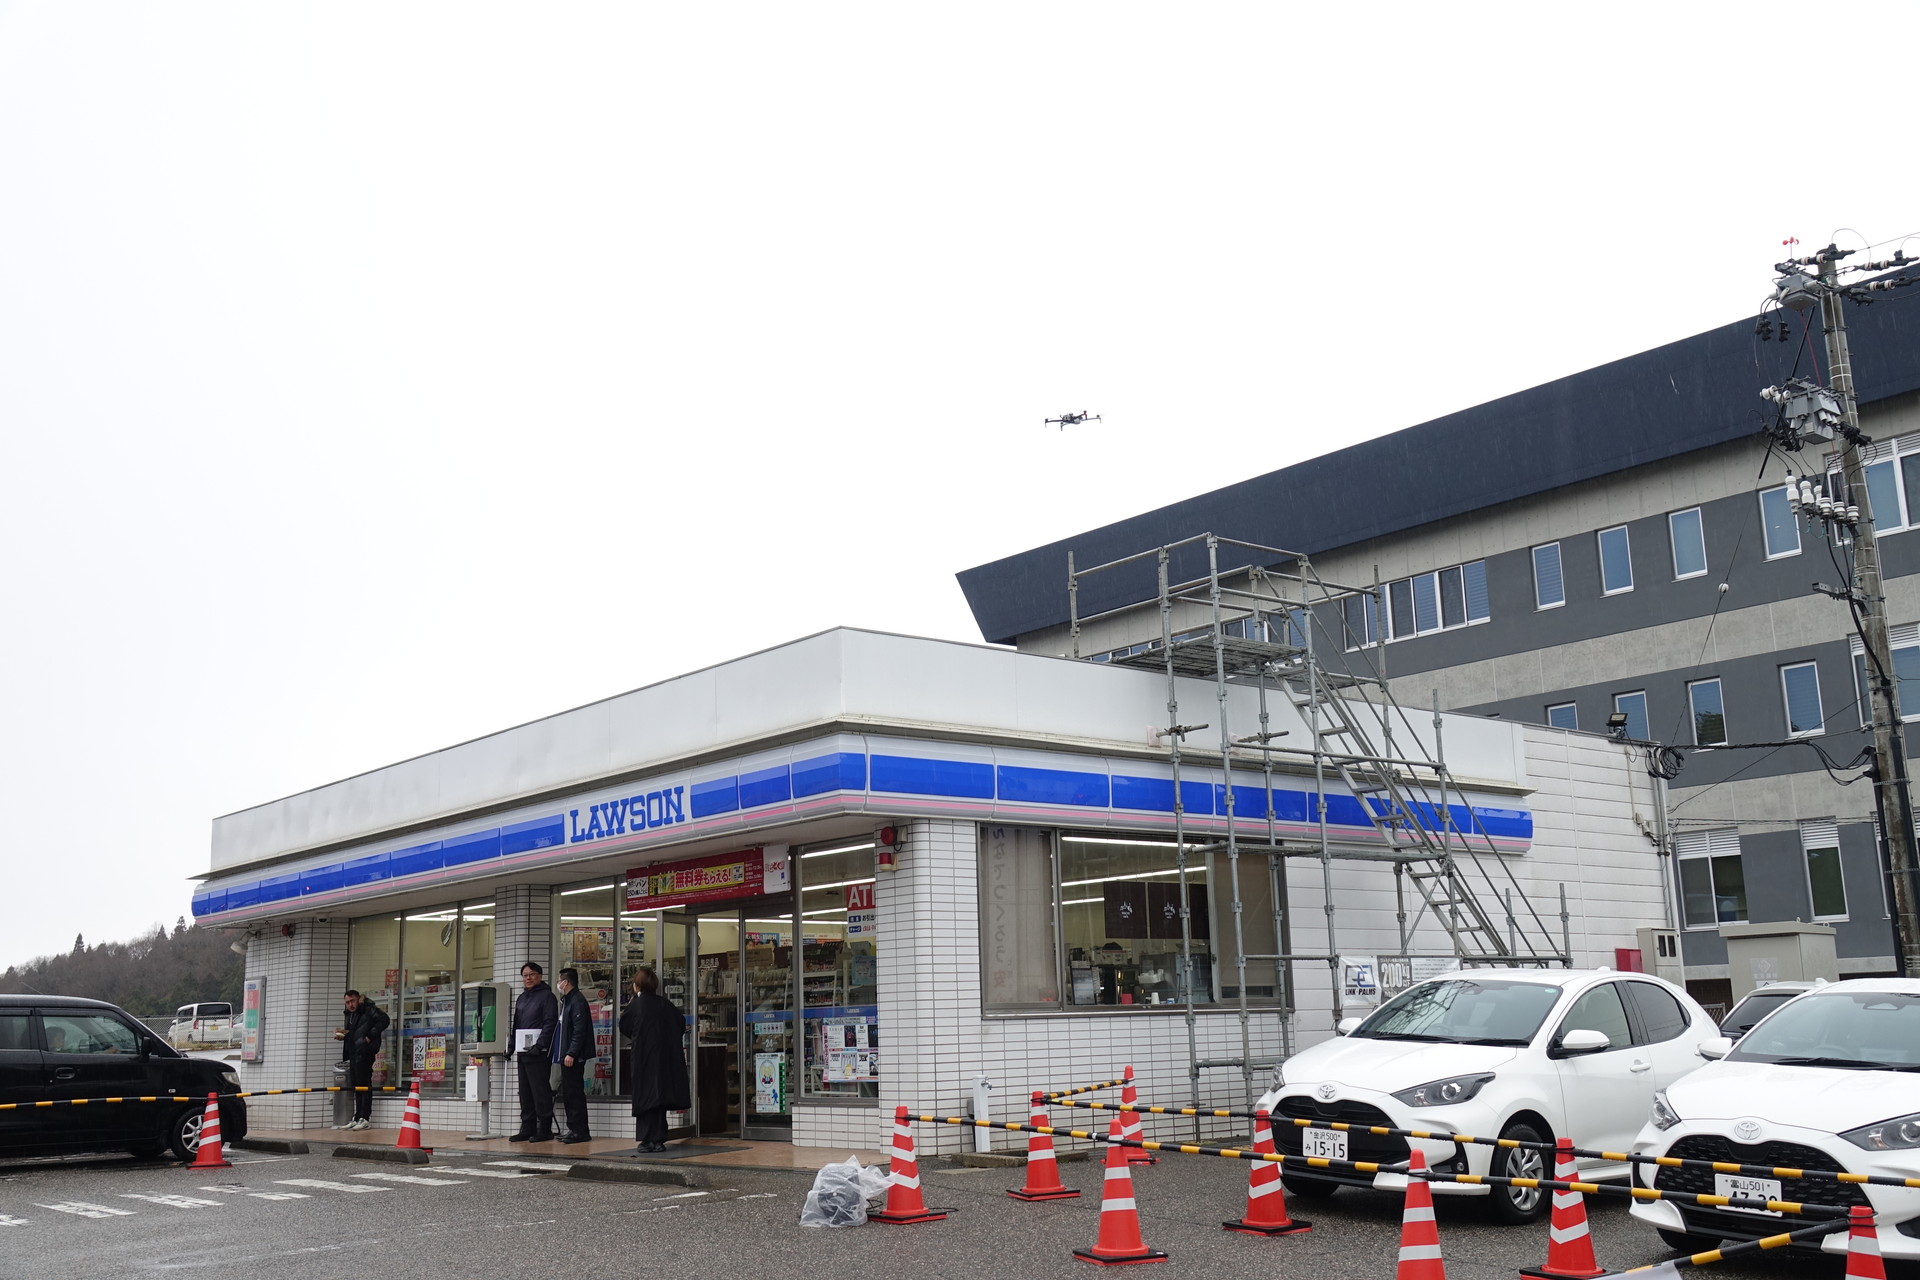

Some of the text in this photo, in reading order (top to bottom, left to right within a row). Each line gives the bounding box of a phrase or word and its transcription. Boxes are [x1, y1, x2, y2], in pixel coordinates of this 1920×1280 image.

[570, 786, 685, 843] LAWSON
[1381, 962, 1402, 988] 200
[1313, 1131, 1338, 1141] 金沢500
[1314, 1140, 1346, 1159] 15-15
[1730, 1178, 1765, 1192] 富山501
